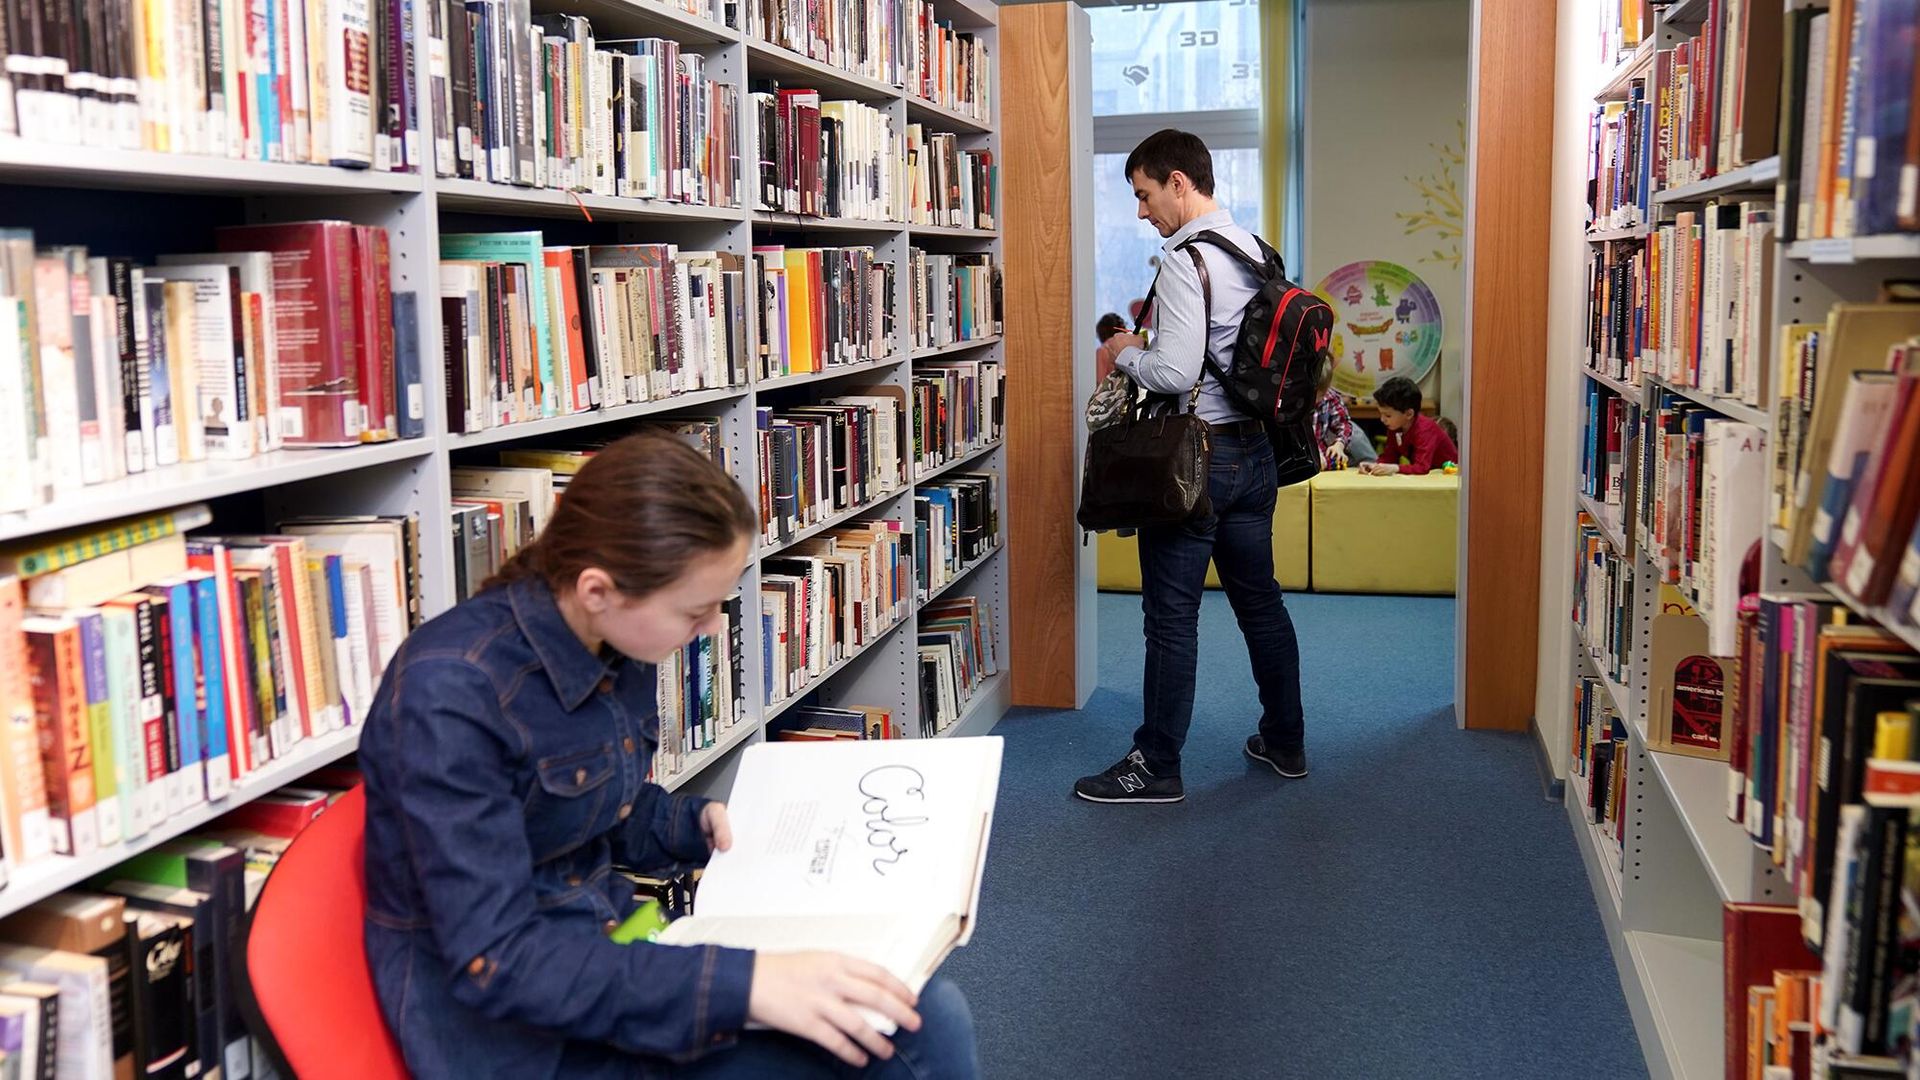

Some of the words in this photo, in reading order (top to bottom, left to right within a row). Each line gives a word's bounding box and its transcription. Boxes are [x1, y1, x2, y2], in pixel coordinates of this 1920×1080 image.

[1180, 30, 1219, 47] 3D
[1676, 684, 1715, 696] american
[1691, 733, 1708, 741] carl
[1117, 772, 1146, 793] N
